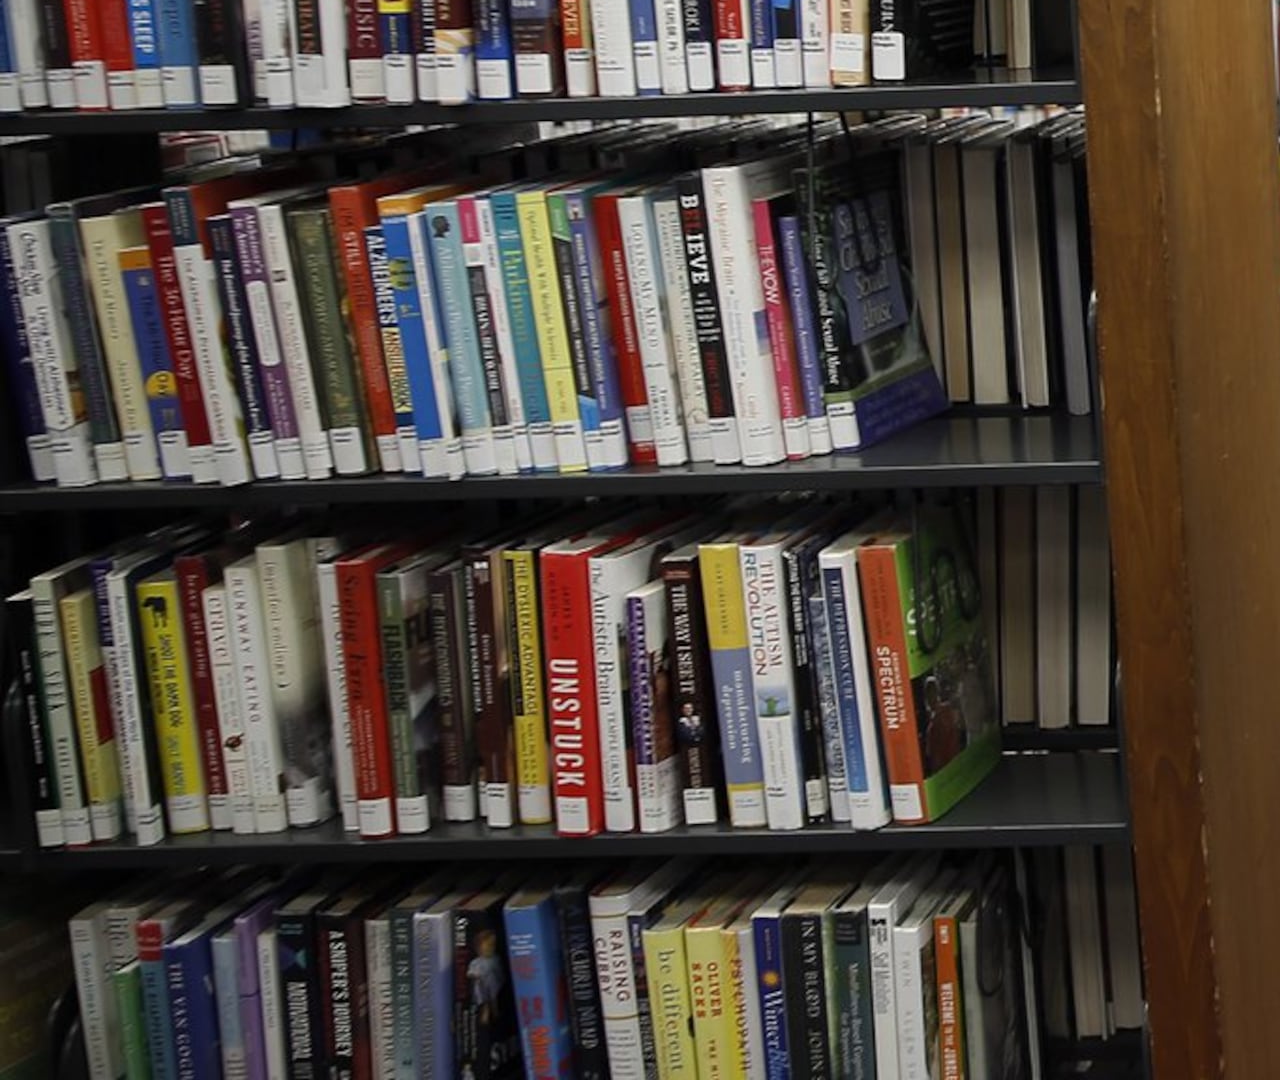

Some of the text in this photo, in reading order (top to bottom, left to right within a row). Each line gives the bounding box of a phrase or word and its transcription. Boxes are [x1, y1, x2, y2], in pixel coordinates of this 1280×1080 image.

[134, 10, 156, 54] SLEEP
[342, 230, 360, 270] STILL
[760, 245, 780, 306] THE VOW
[157, 255, 190, 380] The Day
[517, 584, 534, 640] DYSLEXIC
[592, 590, 617, 657] Autistic
[672, 584, 690, 618] THE
[673, 620, 692, 642] WAY
[743, 552, 767, 677] REVOLUTION
[760, 559, 783, 668] THE AUTISM
[232, 578, 260, 724] RUNAWAY EATING
[596, 661, 613, 707] Brain
[676, 652, 694, 679] SEE
[679, 681, 694, 694] IT
[720, 684, 738, 750] depression
[732, 670, 753, 764] manufacturing
[876, 646, 898, 730] SPECTRUM
[549, 658, 586, 787] UNSTUCK
[327, 930, 352, 1057] A SNIPER'S JOURNEY
[609, 930, 630, 1003] RAISING
[691, 963, 706, 1019] SACKS
[706, 962, 723, 1019] OLIVER
[801, 921, 823, 1072] IN MY BLOOD JOHN
[656, 950, 684, 1071] be different
[939, 982, 954, 1024] WELCOME
